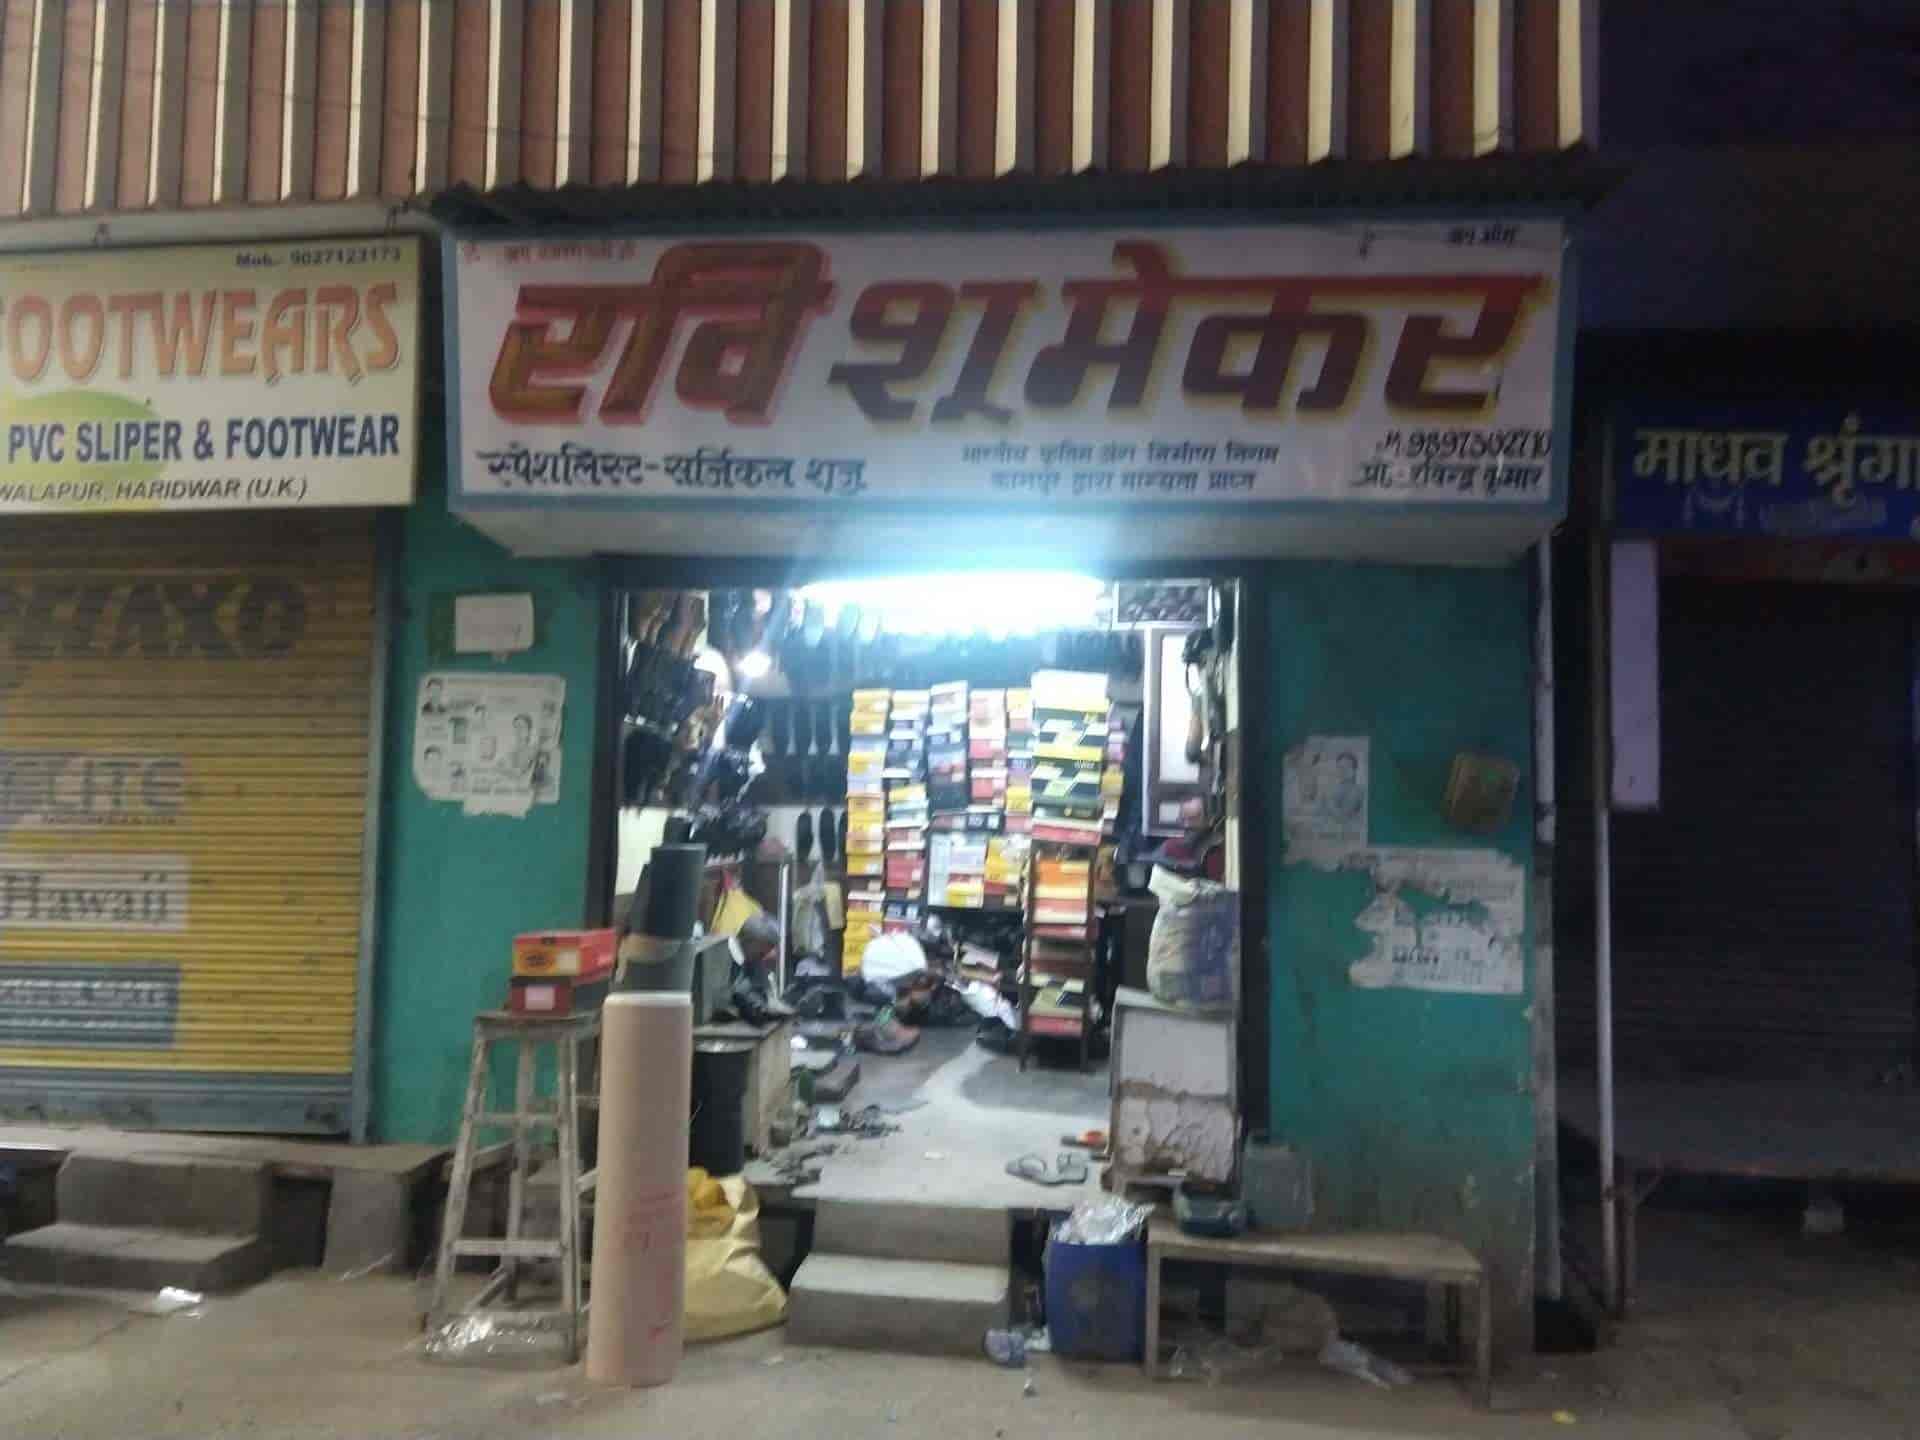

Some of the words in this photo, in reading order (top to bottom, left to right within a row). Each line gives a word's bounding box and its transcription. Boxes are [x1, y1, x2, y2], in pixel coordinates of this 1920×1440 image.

[0, 282, 402, 387] OOTWEARS
[8, 421, 65, 463] PVC
[75, 420, 183, 462] SLIPER
[192, 418, 215, 461] &
[226, 414, 400, 460] FOOTWEAR
[1632, 428, 1789, 487] माधव
[115, 478, 241, 500] HARIDWAR
